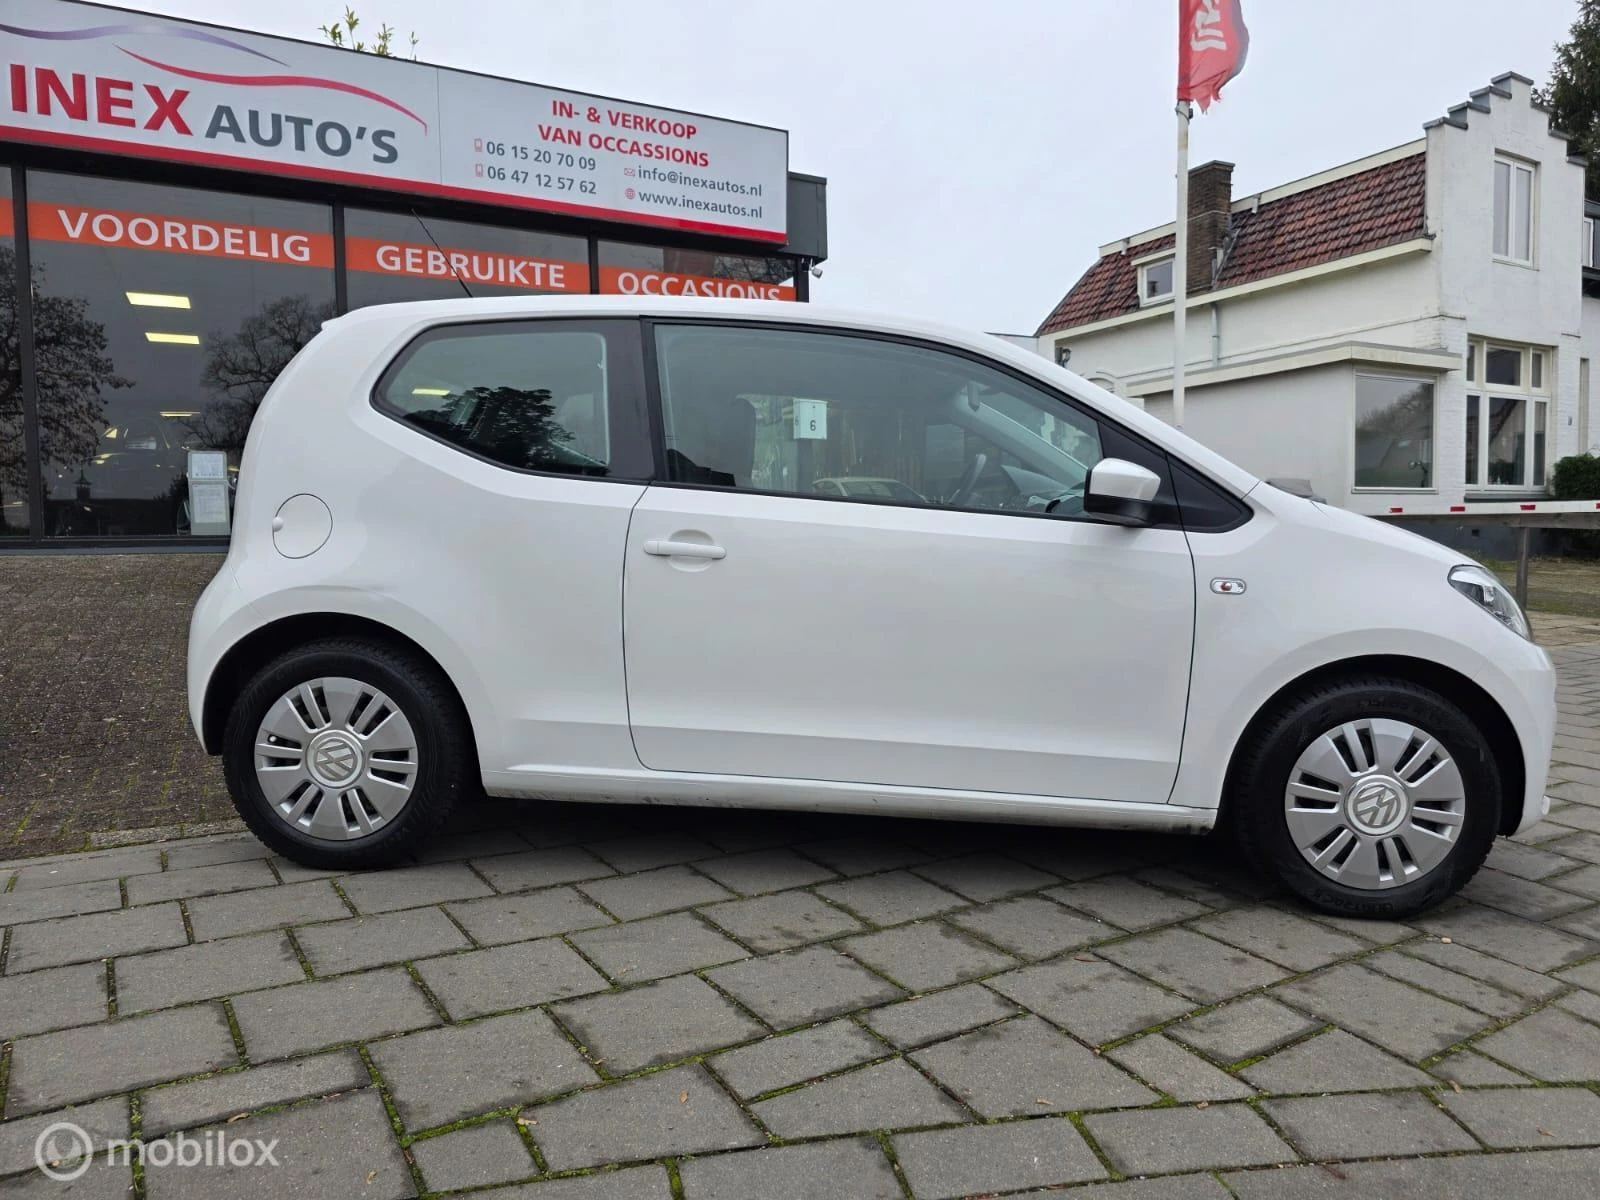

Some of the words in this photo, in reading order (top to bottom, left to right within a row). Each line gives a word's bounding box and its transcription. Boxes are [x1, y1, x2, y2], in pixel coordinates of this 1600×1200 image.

[10, 63, 194, 136] INEX
[204, 104, 399, 164] AUTO'S
[552, 100, 580, 117] IN-
[586, 107, 601, 124] &
[608, 110, 697, 139] VERKOOP
[486, 141, 506, 156] 06
[511, 146, 529, 160] 15
[533, 149, 551, 164] 20
[557, 153, 575, 167] 70
[578, 156, 596, 171] 09
[538, 124, 582, 146] VAN
[588, 133, 709, 167] OCCASSIONS
[487, 165, 506, 181] 06
[511, 170, 529, 184] 47
[535, 173, 552, 188] 12
[557, 178, 575, 192] 57
[579, 180, 597, 195] 62
[638, 165, 763, 197] info@inexautos.nl
[638, 192, 763, 219] www.inexautos.nl
[57, 209, 311, 262] VOORDELIG
[375, 245, 565, 288] GEBRUIKTE
